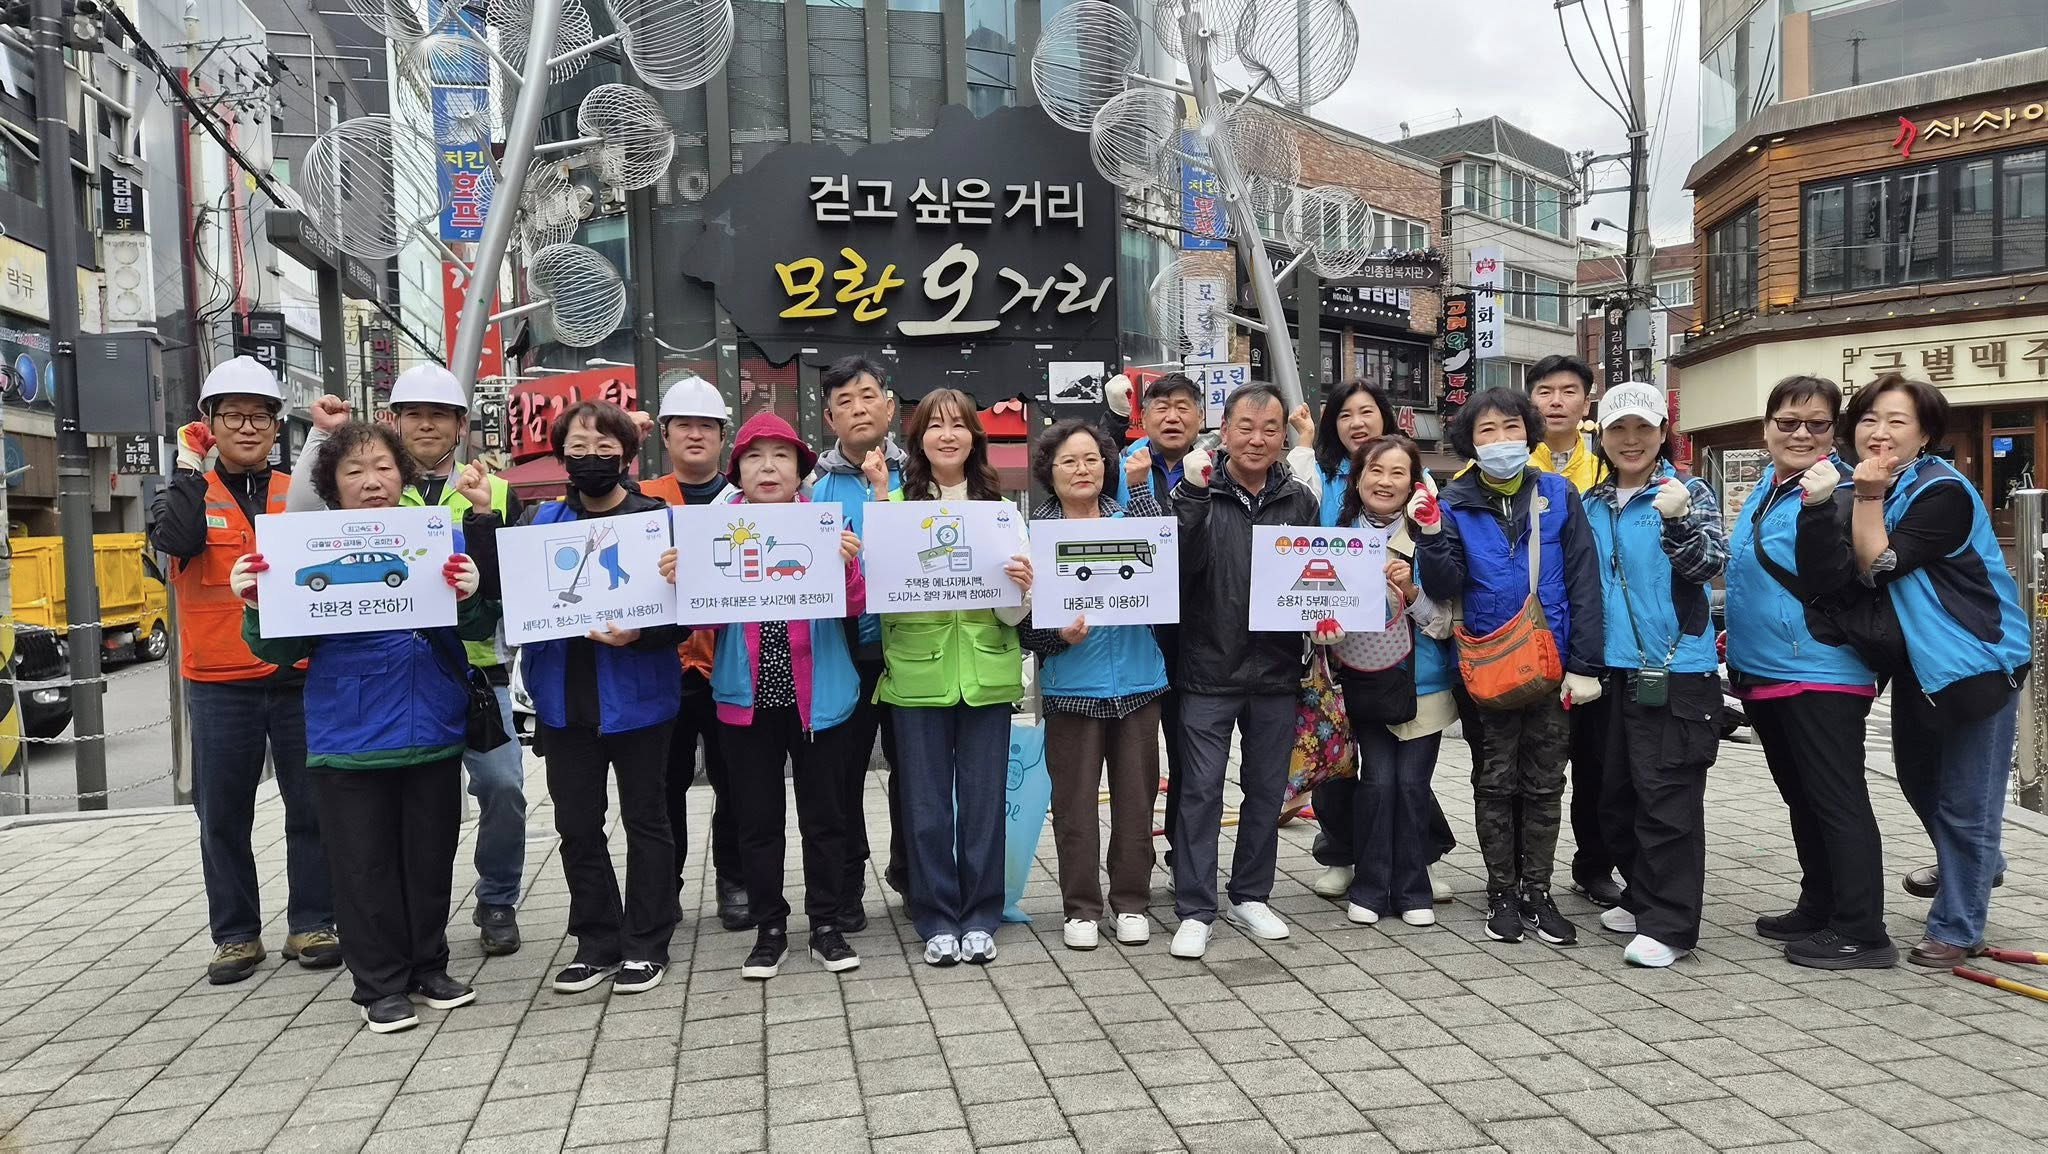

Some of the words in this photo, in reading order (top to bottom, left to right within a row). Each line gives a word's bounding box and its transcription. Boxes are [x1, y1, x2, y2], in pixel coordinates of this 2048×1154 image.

[444, 150, 485, 169] 치킨
[112, 172, 133, 213] 덤펍
[808, 174, 899, 222] 걷고
[908, 177, 996, 225] 싶은
[1004, 180, 1084, 228] 거리
[116, 218, 131, 229] 3F
[460, 229, 475, 238] 2F
[1347, 265, 1425, 279] 노인종합복지관
[7, 267, 35, 299] 락큐
[774, 247, 906, 323] 모란
[1611, 330, 1624, 382] 김성주점
[1210, 367, 1245, 385] 모던
[1210, 389, 1226, 406] 회
[125, 442, 150, 453] 노래
[126, 453, 151, 465] 타운
[904, 578, 929, 588] 주택용
[932, 576, 985, 587] 에너지캐시백,
[760, 594, 796, 606] 낮시간에
[799, 592, 834, 605] 충전하기
[888, 591, 921, 602] 도시가스
[923, 591, 940, 602] 절약
[942, 590, 967, 600] 캐시백
[969, 587, 1001, 599] 참여하기
[1276, 595, 1303, 607] 승용차
[1306, 595, 1360, 608] 5부제(요일제)
[309, 601, 353, 618] 친환경
[357, 598, 414, 615] 운전하기
[1063, 595, 1105, 611] 대중교통
[1108, 595, 1149, 608] 이용하기
[522, 620, 553, 632] 세탁기,
[555, 613, 593, 627] 청소기는
[595, 608, 623, 621] 주말에
[626, 603, 663, 617] 사용하기
[1301, 609, 1335, 621] 참여하기
